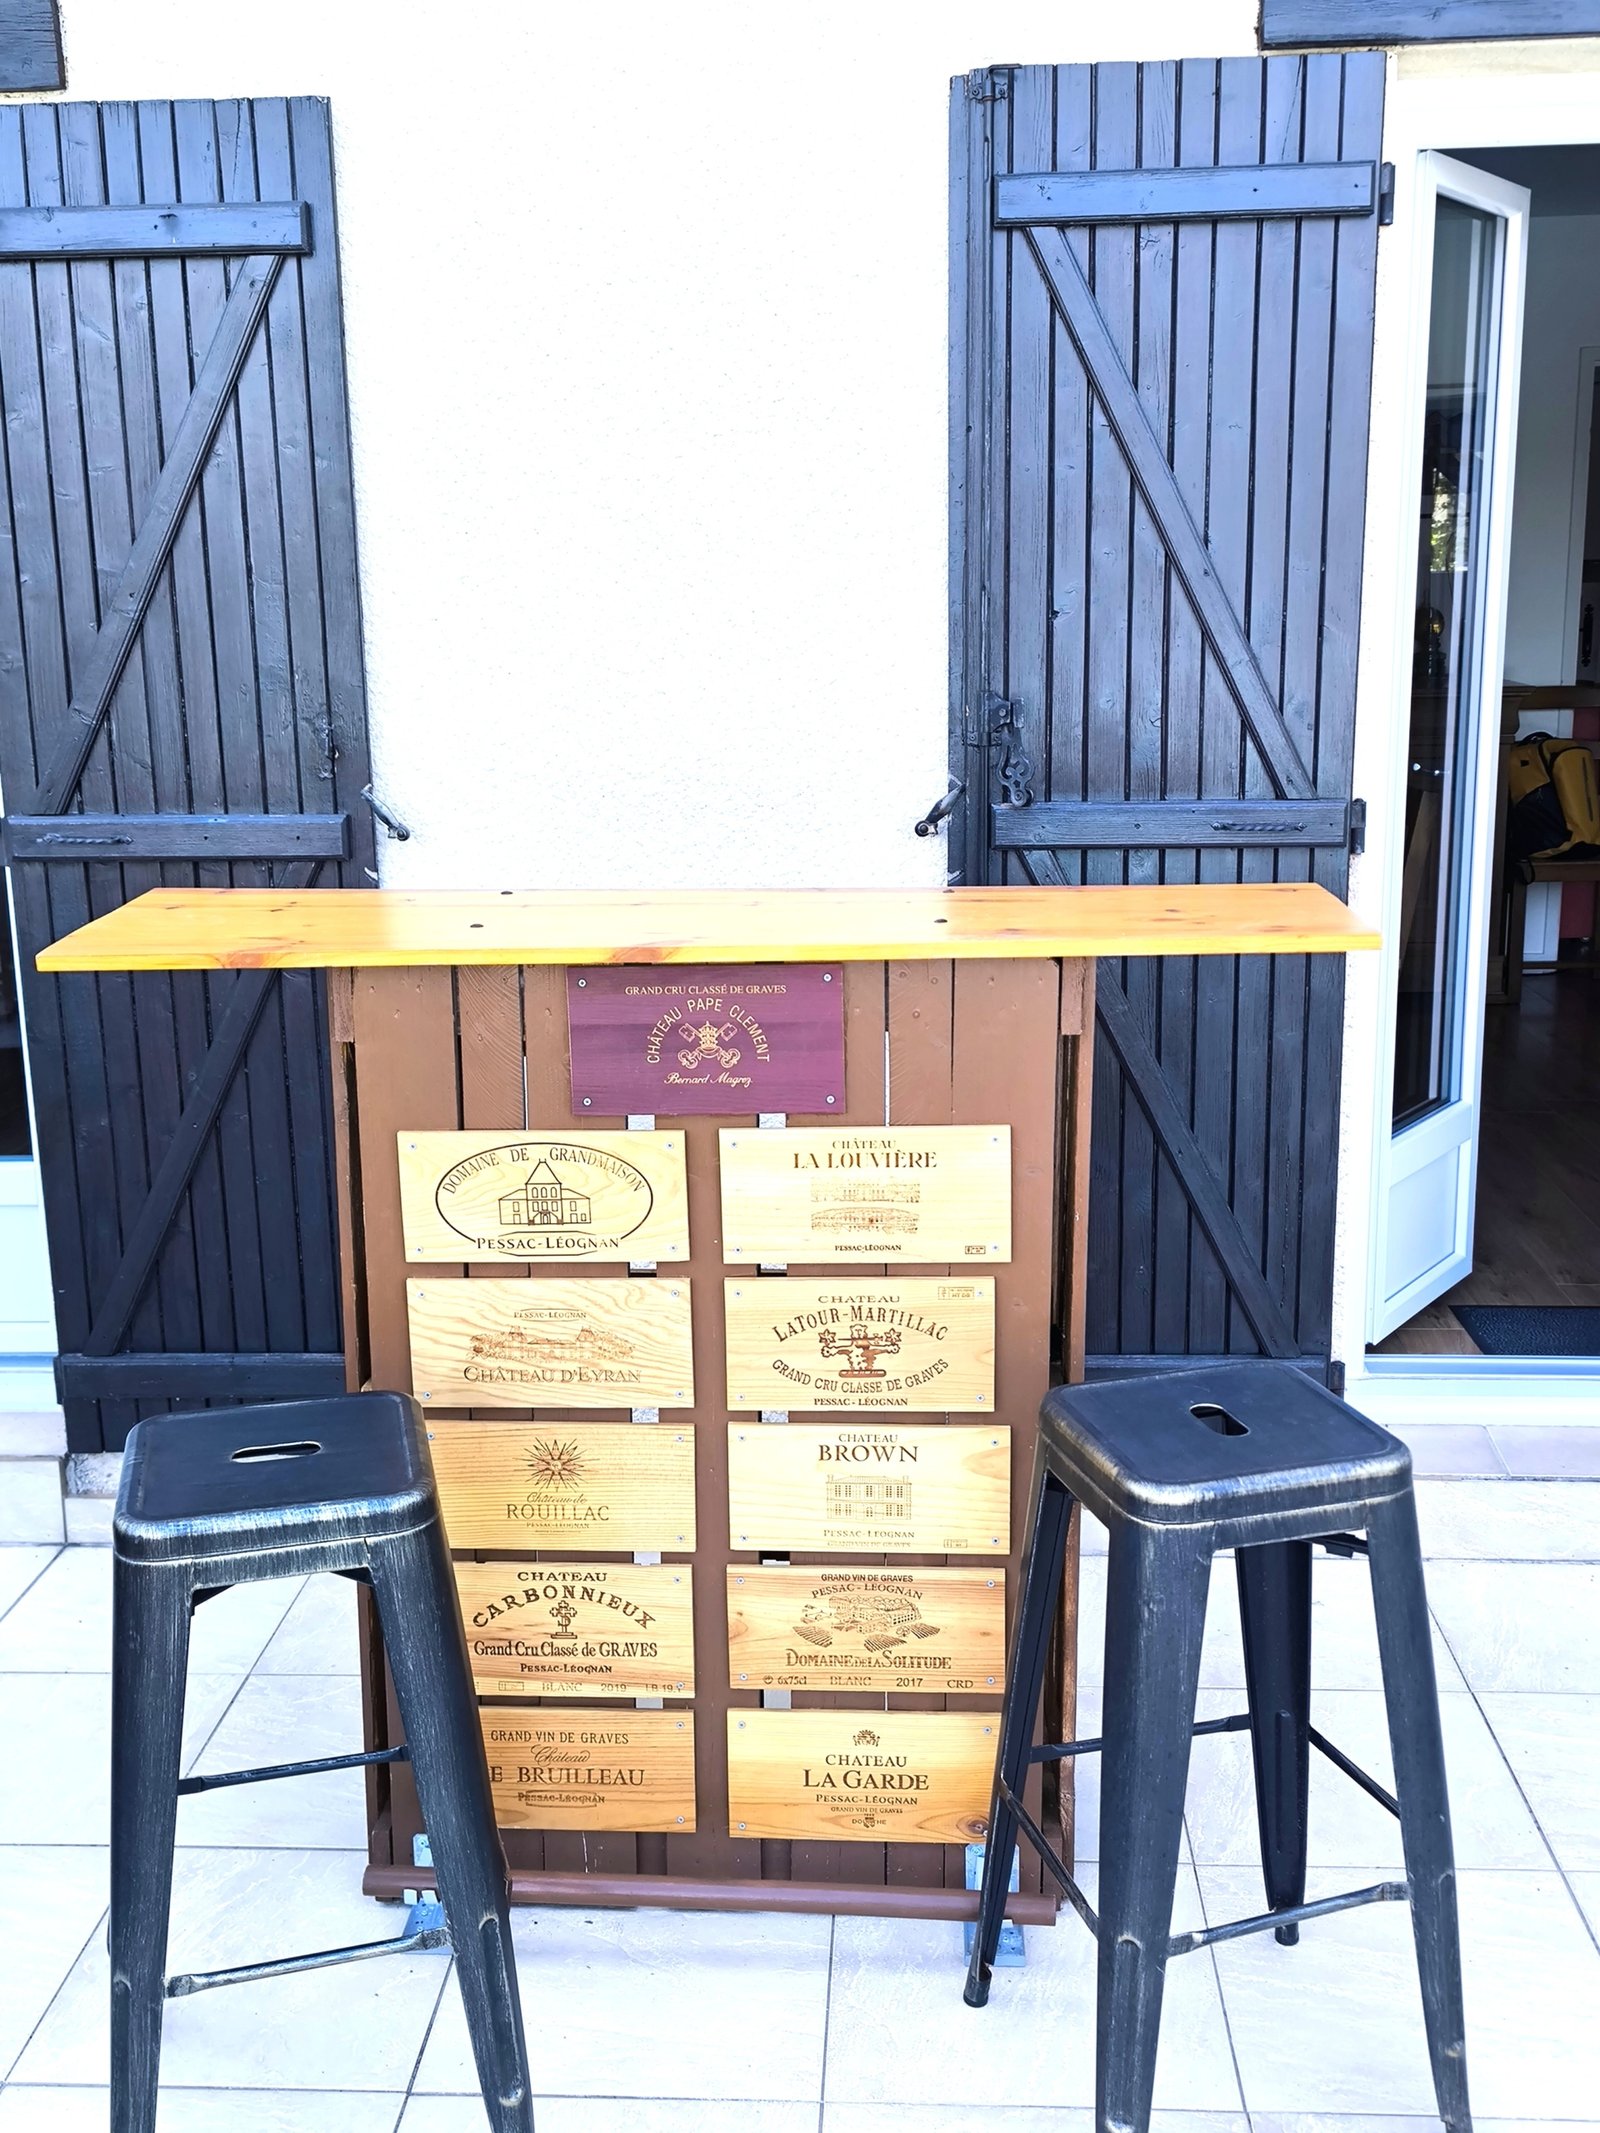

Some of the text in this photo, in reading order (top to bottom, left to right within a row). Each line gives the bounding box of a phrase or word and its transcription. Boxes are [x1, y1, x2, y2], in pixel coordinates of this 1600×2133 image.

[625, 983, 786, 995] GRAND CRU CLASSÉ DE GRAVES
[646, 997, 770, 1064] CHÂTEAU PAPE CLEMENT
[664, 1072, 752, 1087] Bernard Magrez
[793, 1149, 937, 1169] LA LOUVIÈRE
[442, 1147, 645, 1194] DOMAINE DE GRANDMAISON
[463, 1366, 555, 1383] CHÂTEAU
[772, 1358, 949, 1393] GRAND CRU CLASSE DE GRAVES
[818, 1445, 919, 1462] BROWN
[507, 1504, 609, 1521] ROUILLAC
[517, 1571, 608, 1582] CHATEAU
[472, 1584, 656, 1629] CARBONNIEUX
[473, 1641, 658, 1657] Grand Cru Classé de GRAVES
[786, 1649, 853, 1668] DOMAINE
[881, 1650, 952, 1669] SOLITUDE
[542, 1682, 583, 1692] BLANC
[600, 1684, 627, 1692] 2019
[830, 1676, 872, 1686] BLANC
[896, 1677, 924, 1688] 2017
[947, 1679, 974, 1689] CRD
[490, 1730, 629, 1744] GRAND VIN DE GRAVES
[530, 1744, 591, 1767] Château
[825, 1754, 907, 1768] CHATEAU
[490, 1766, 645, 1785] E BRUILLEAU
[803, 1769, 929, 1790] LA GARDE
[816, 1794, 918, 1805] PESSAC-LÉOGNAN
